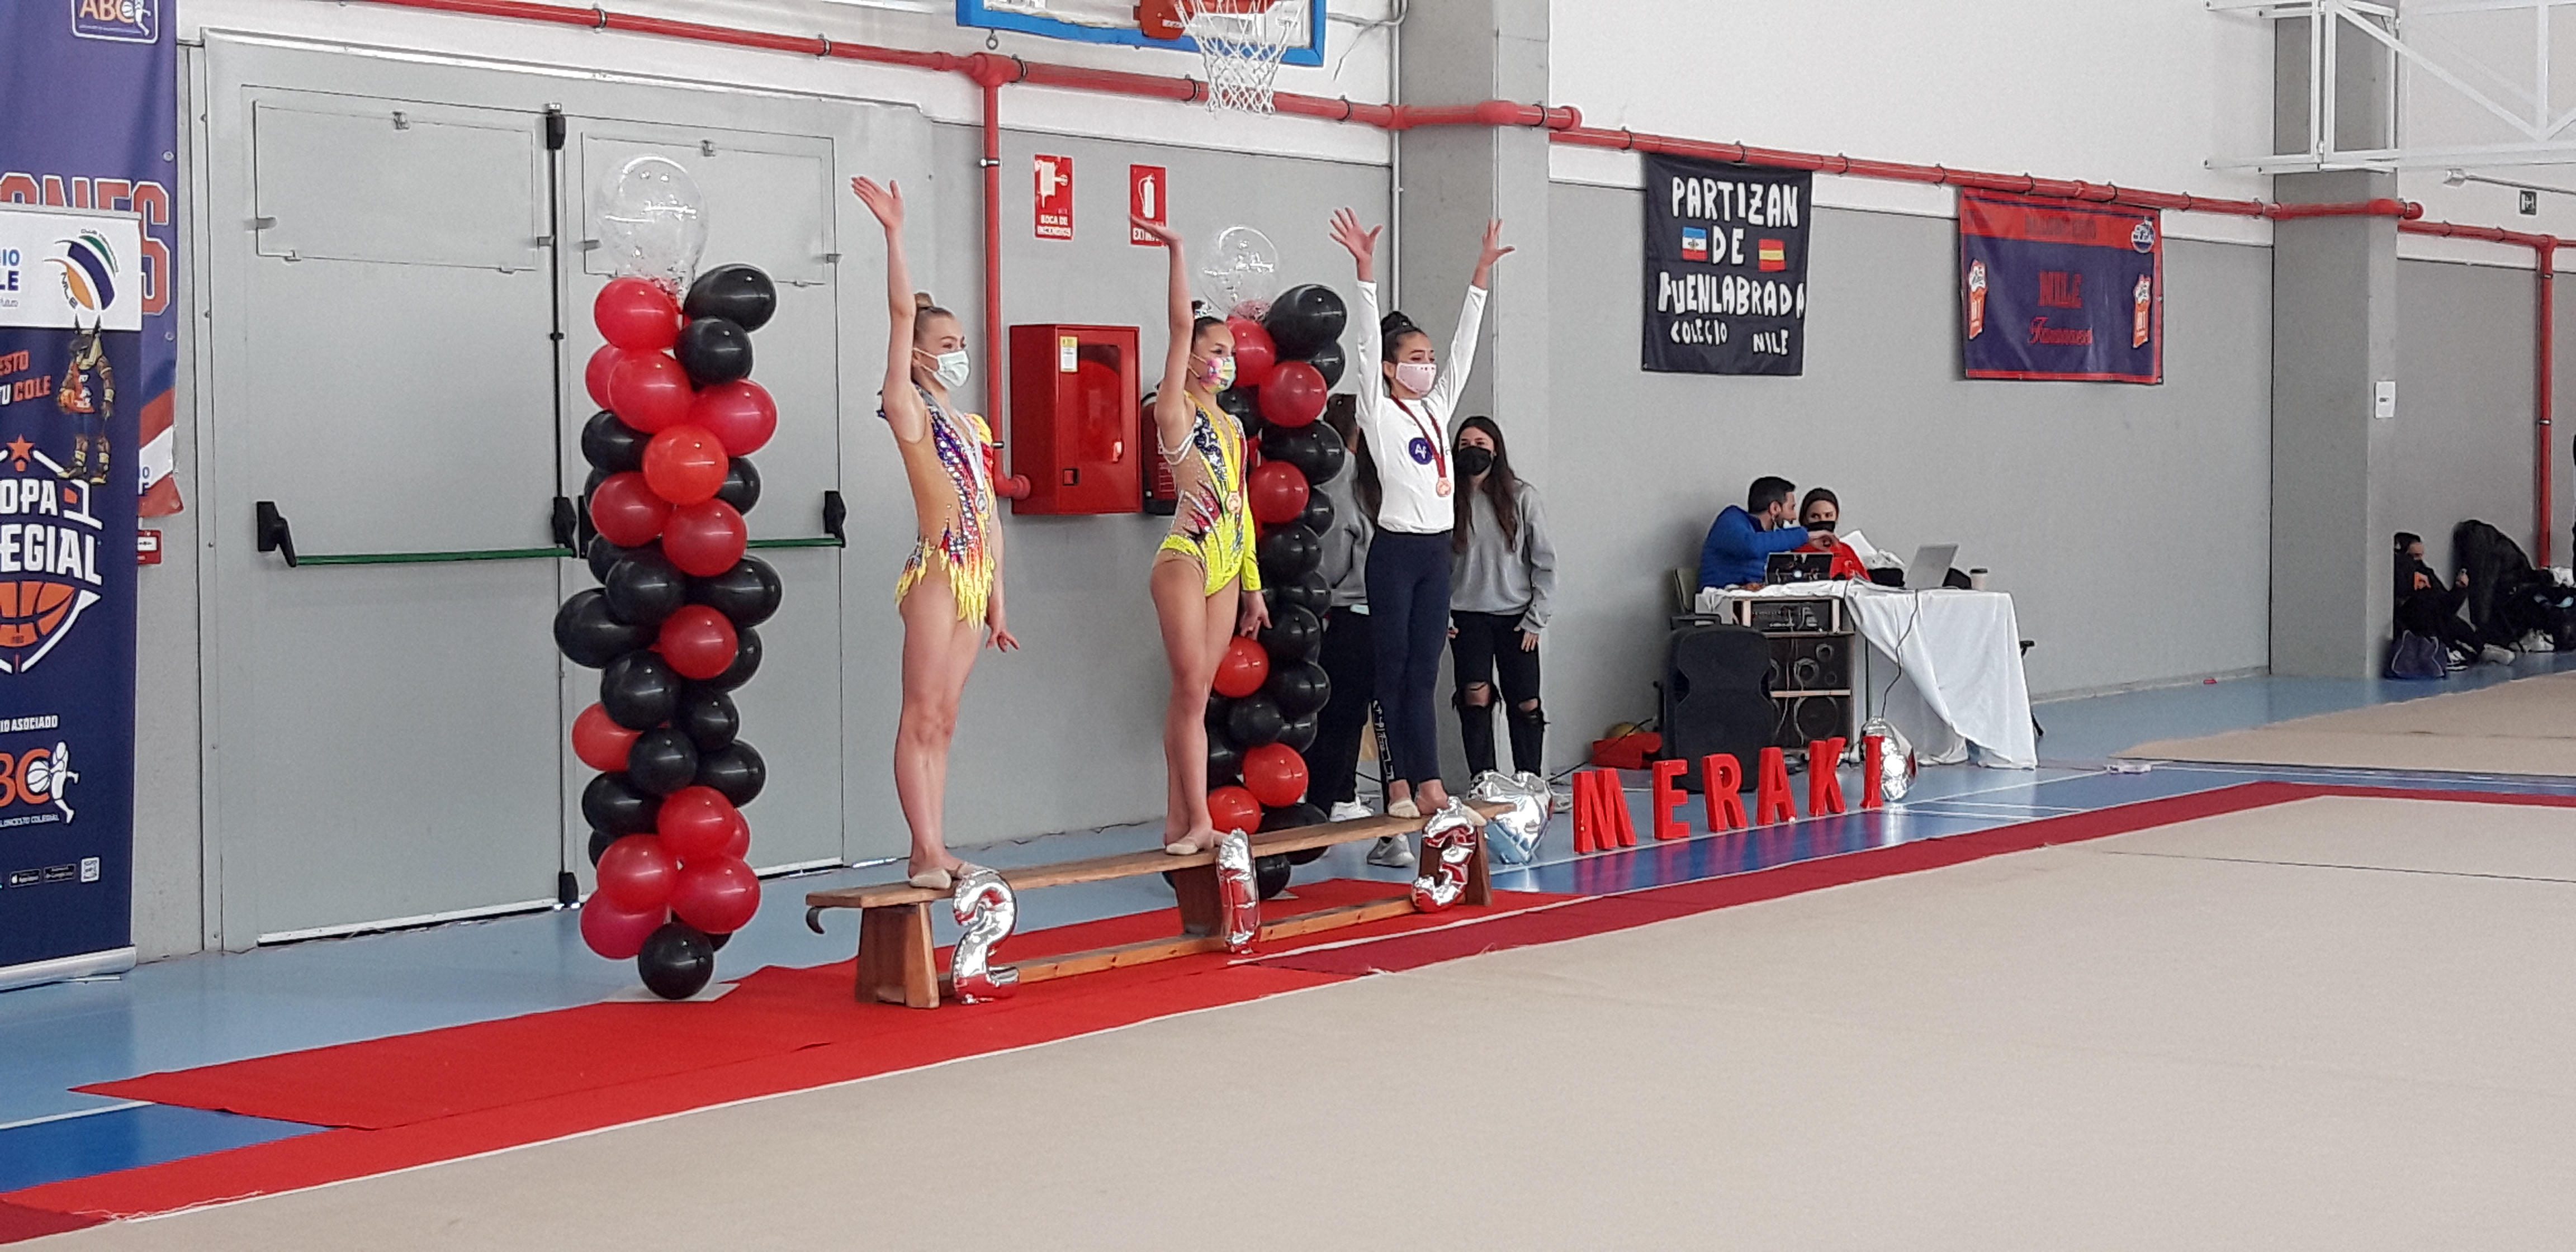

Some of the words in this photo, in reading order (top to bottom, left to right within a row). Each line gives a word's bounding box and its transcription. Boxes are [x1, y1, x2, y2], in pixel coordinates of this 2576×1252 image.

[1671, 176, 1798, 227] PARTIZAN
[1712, 225, 1744, 265] DE
[1670, 318, 1728, 346] COLEGIO
[1753, 329, 1789, 355] NILE
[12, 375, 51, 402] COLE
[11, 715, 58, 731] ASOCIADO
[1573, 736, 1885, 853] MERAKI
